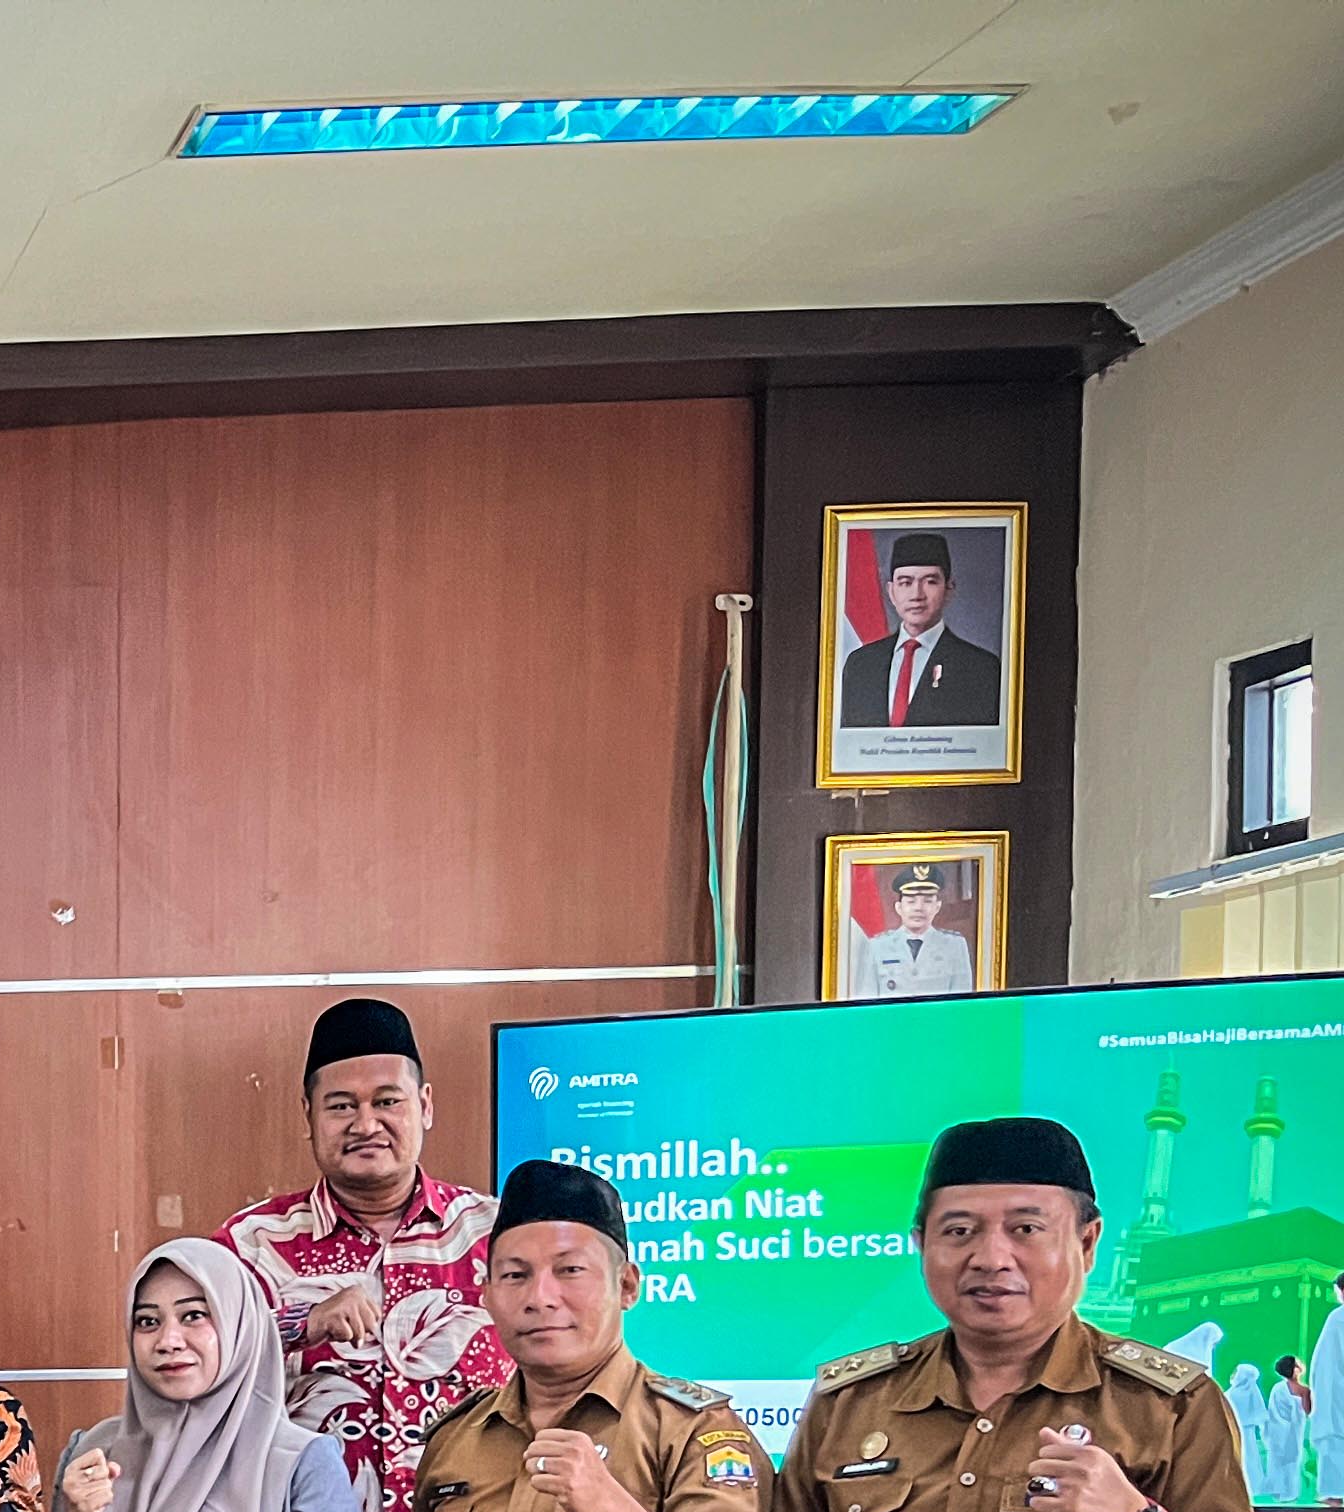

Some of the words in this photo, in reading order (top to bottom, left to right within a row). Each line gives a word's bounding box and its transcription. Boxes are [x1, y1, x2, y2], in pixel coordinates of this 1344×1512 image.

[1099, 1022, 1344, 1048] #SemuaBisaHajiBersamaAM
[568, 1072, 639, 1088] AMITRA
[621, 1191, 732, 1223] udkan
[745, 1188, 824, 1219] Niat
[715, 1228, 791, 1260] Suci
[803, 1230, 920, 1258] bersa
